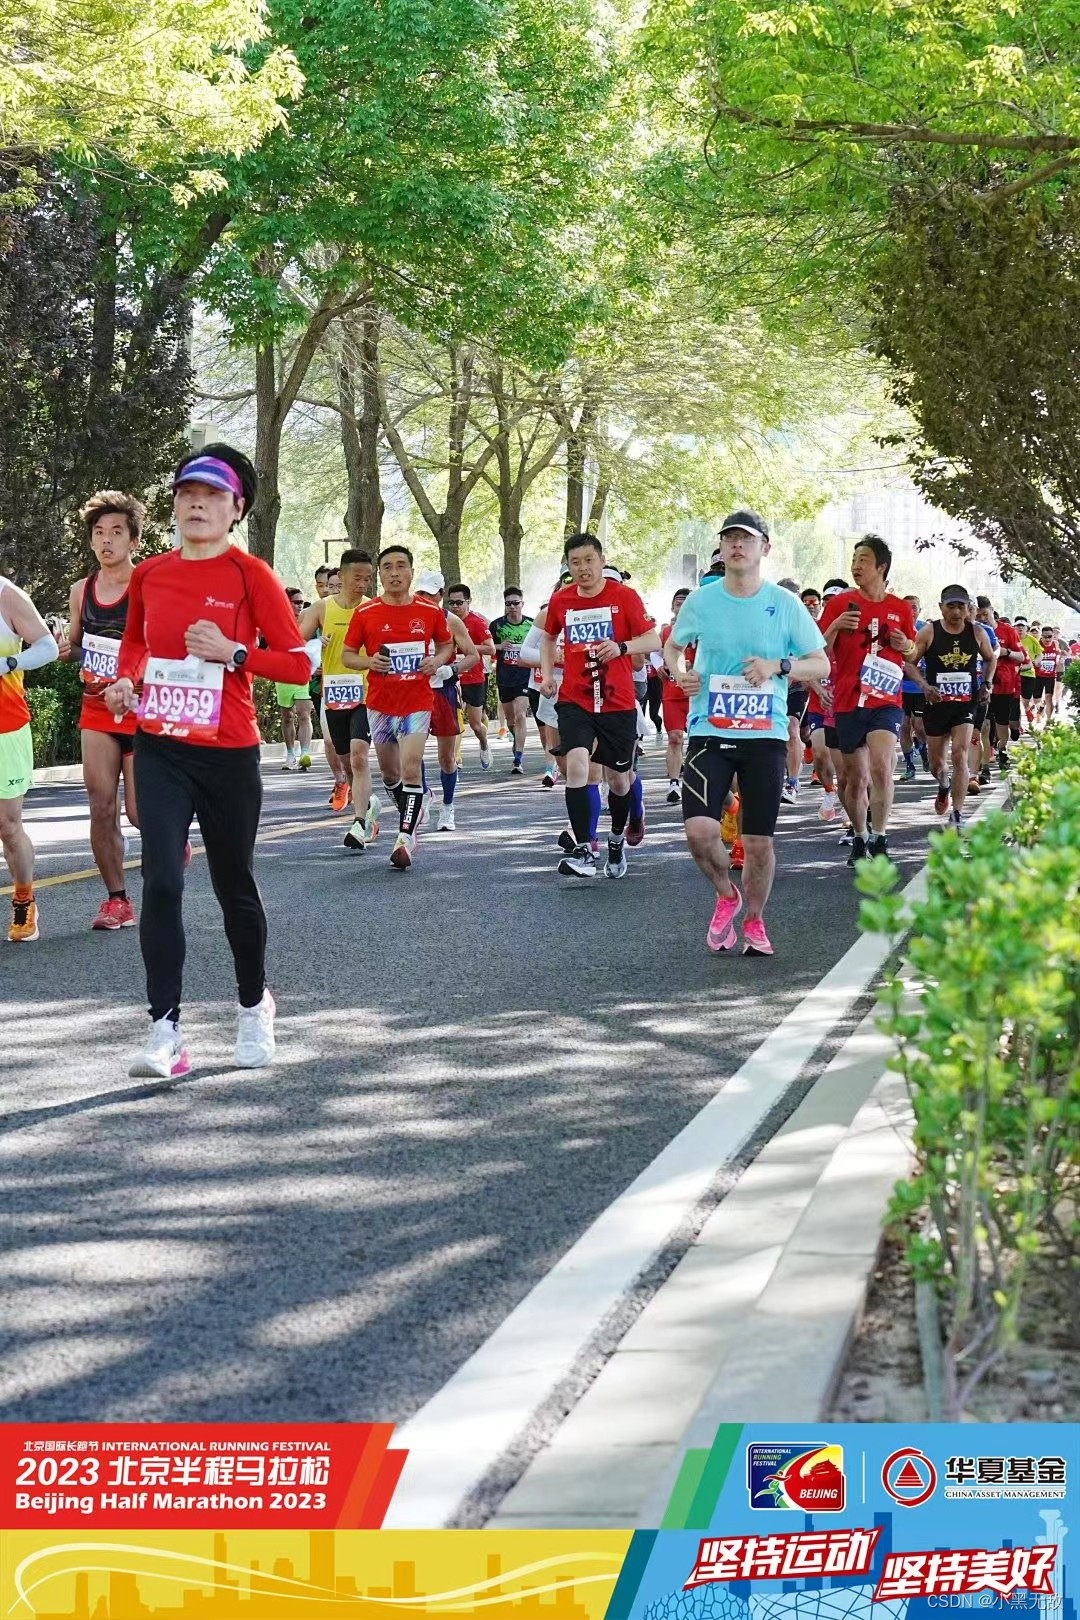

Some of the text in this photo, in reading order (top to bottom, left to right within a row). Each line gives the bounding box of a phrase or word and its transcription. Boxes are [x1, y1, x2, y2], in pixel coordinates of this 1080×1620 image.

[570, 622, 609, 642] A3217
[83, 651, 118, 675] A088
[861, 668, 899, 693] A3777
[939, 683, 970, 696] A3142
[145, 685, 214, 720] A9959
[327, 686, 361, 702] A5219
[712, 694, 768, 715] A1284
[403, 794, 416, 824] bmai
